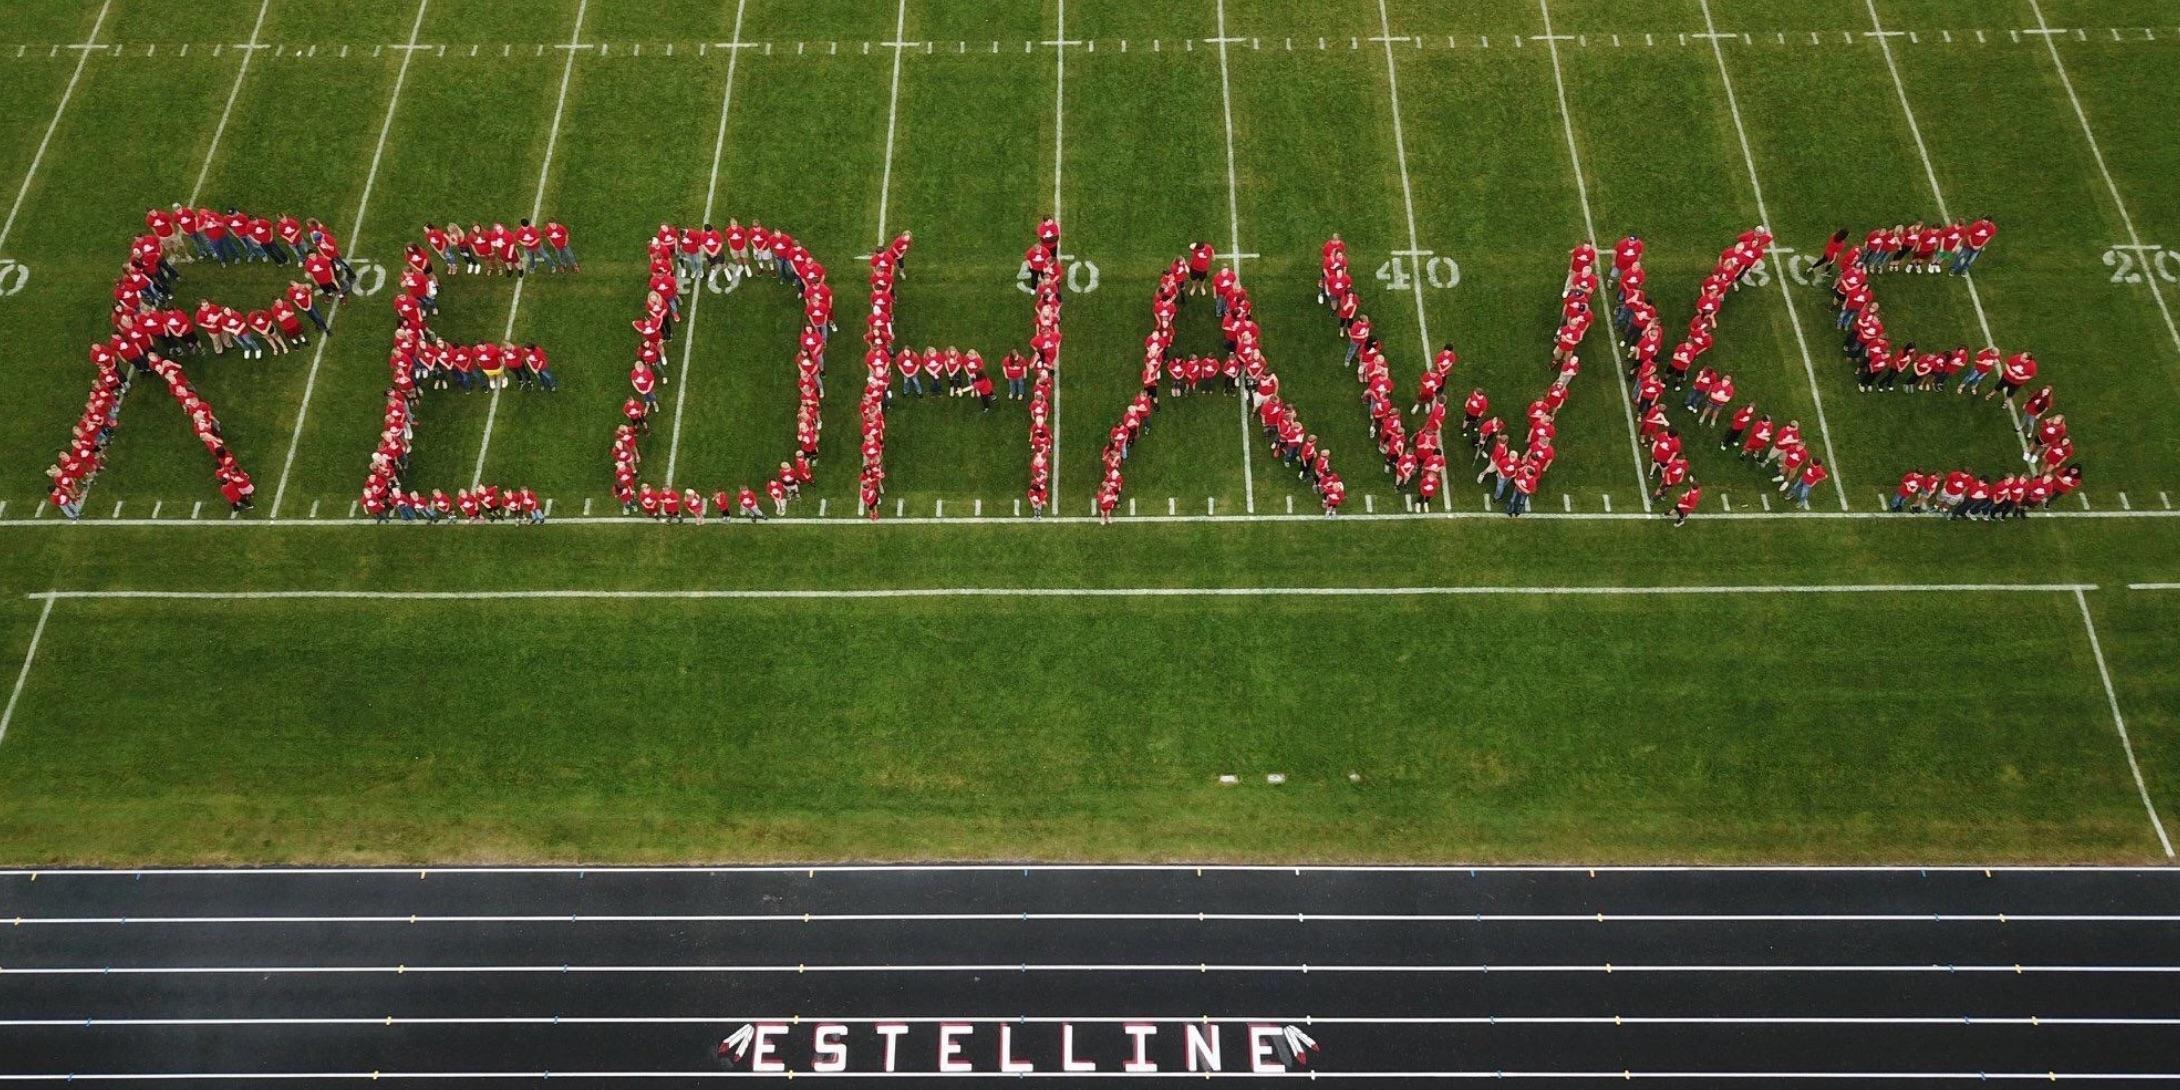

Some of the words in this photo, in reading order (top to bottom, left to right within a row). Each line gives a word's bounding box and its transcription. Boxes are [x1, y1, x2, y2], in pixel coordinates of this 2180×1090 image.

[1376, 257, 1460, 290] 40
[2102, 251, 2180, 283] 20
[46, 202, 2083, 524] REDHAWKS
[750, 1022, 1286, 1072] ESTELLINE
